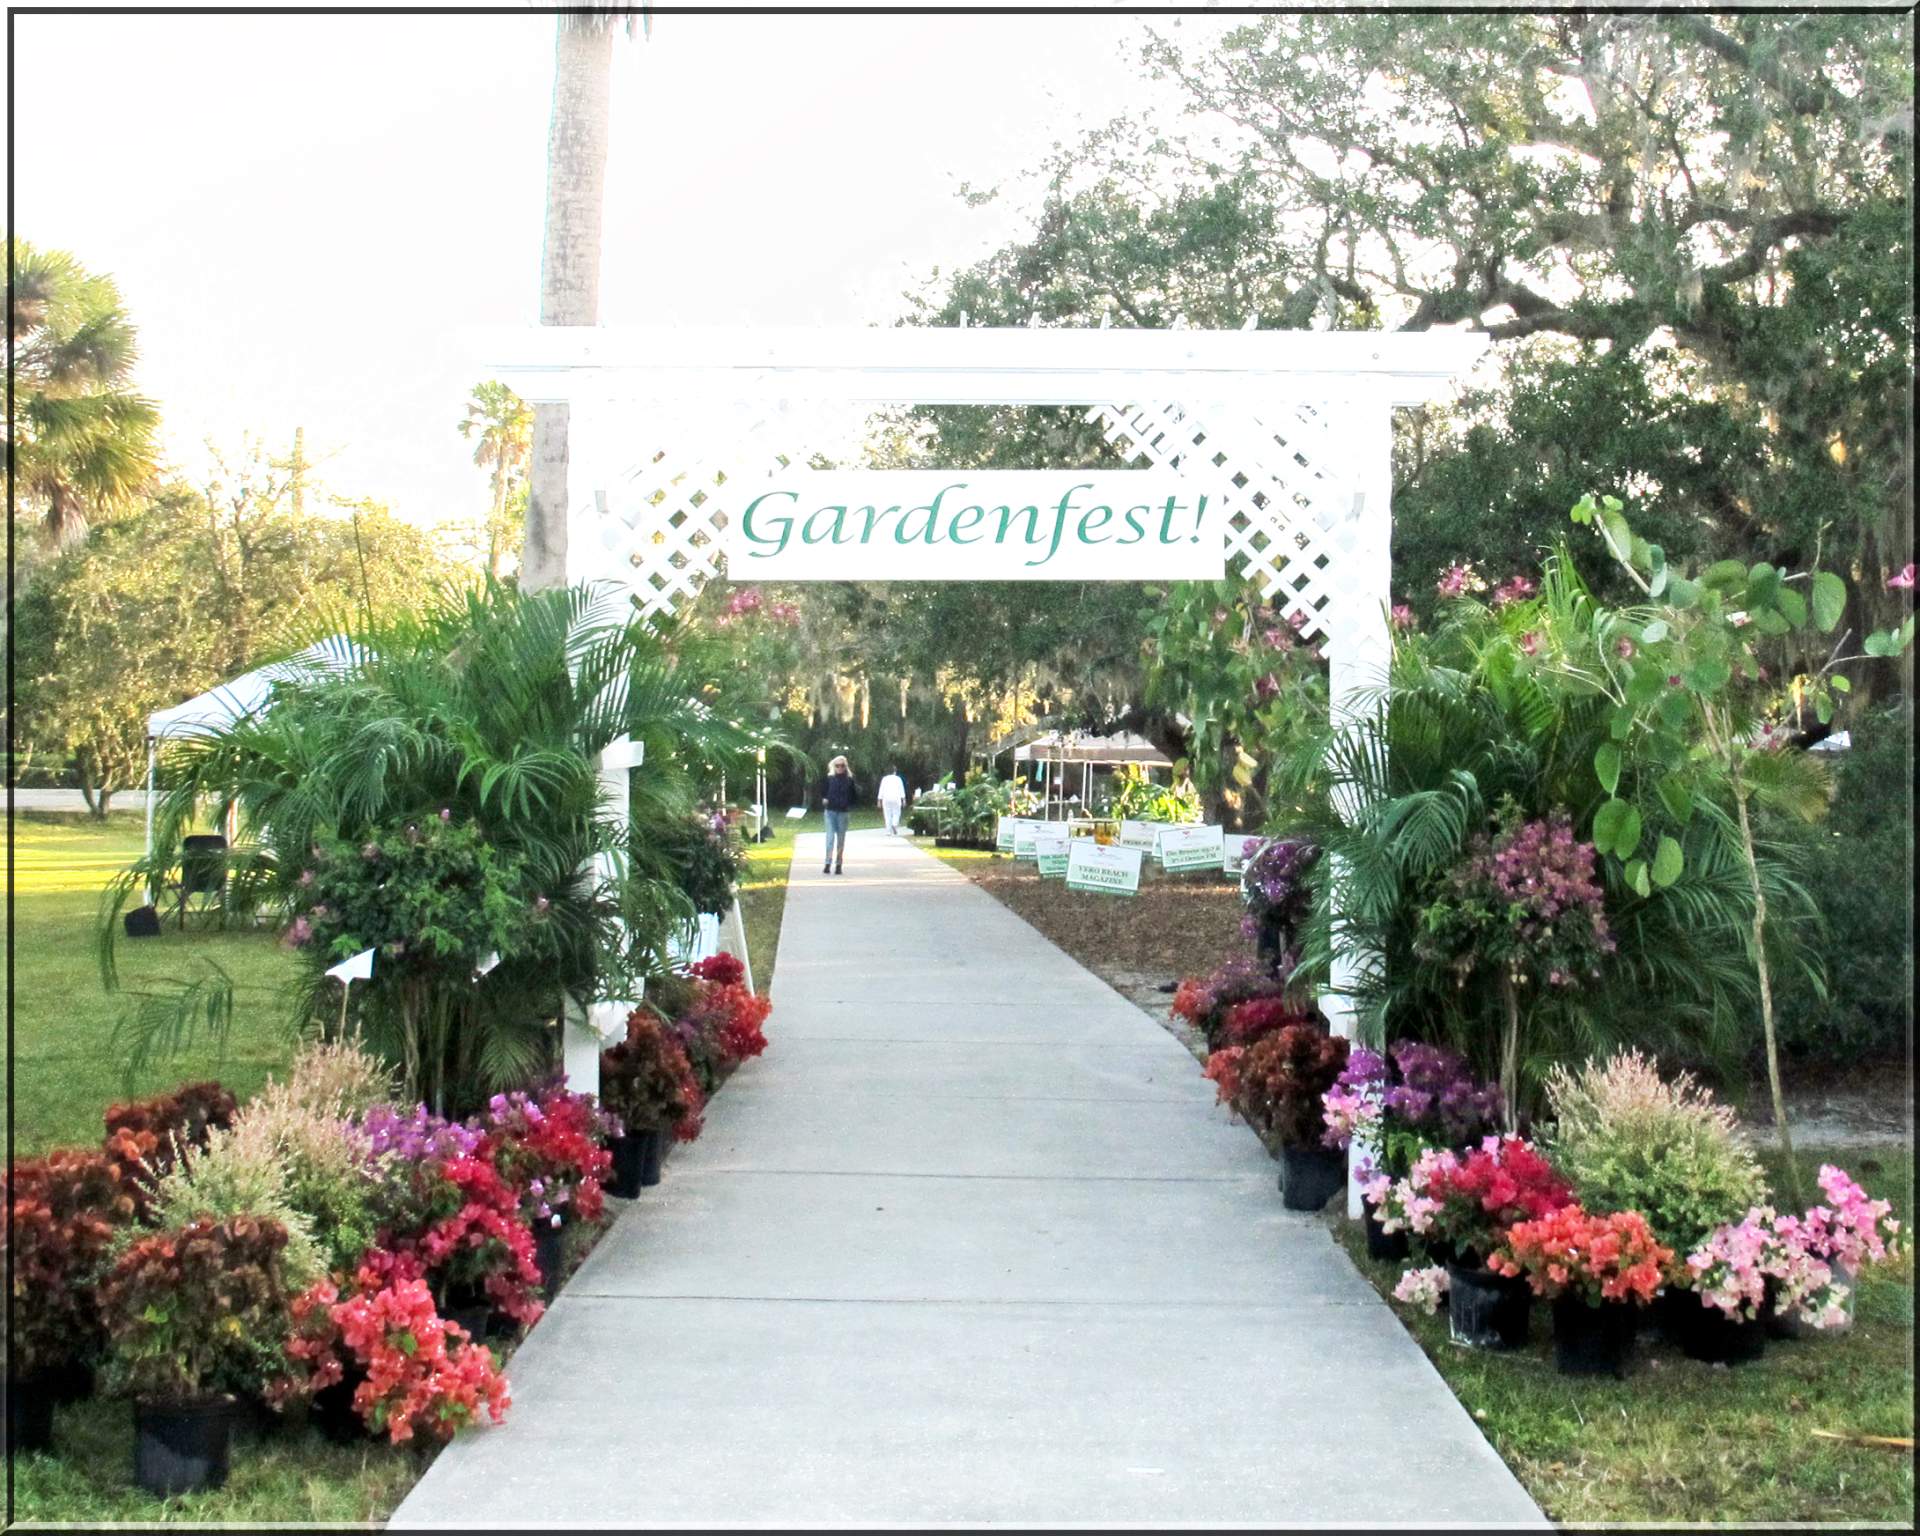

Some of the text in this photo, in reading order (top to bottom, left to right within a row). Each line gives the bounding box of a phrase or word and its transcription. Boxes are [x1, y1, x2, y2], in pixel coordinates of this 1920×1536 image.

[742, 483, 1208, 566] Gardenfest!
[1079, 865, 1128, 878] VERO BEACH
[1082, 873, 1123, 885] MAGAZINE
